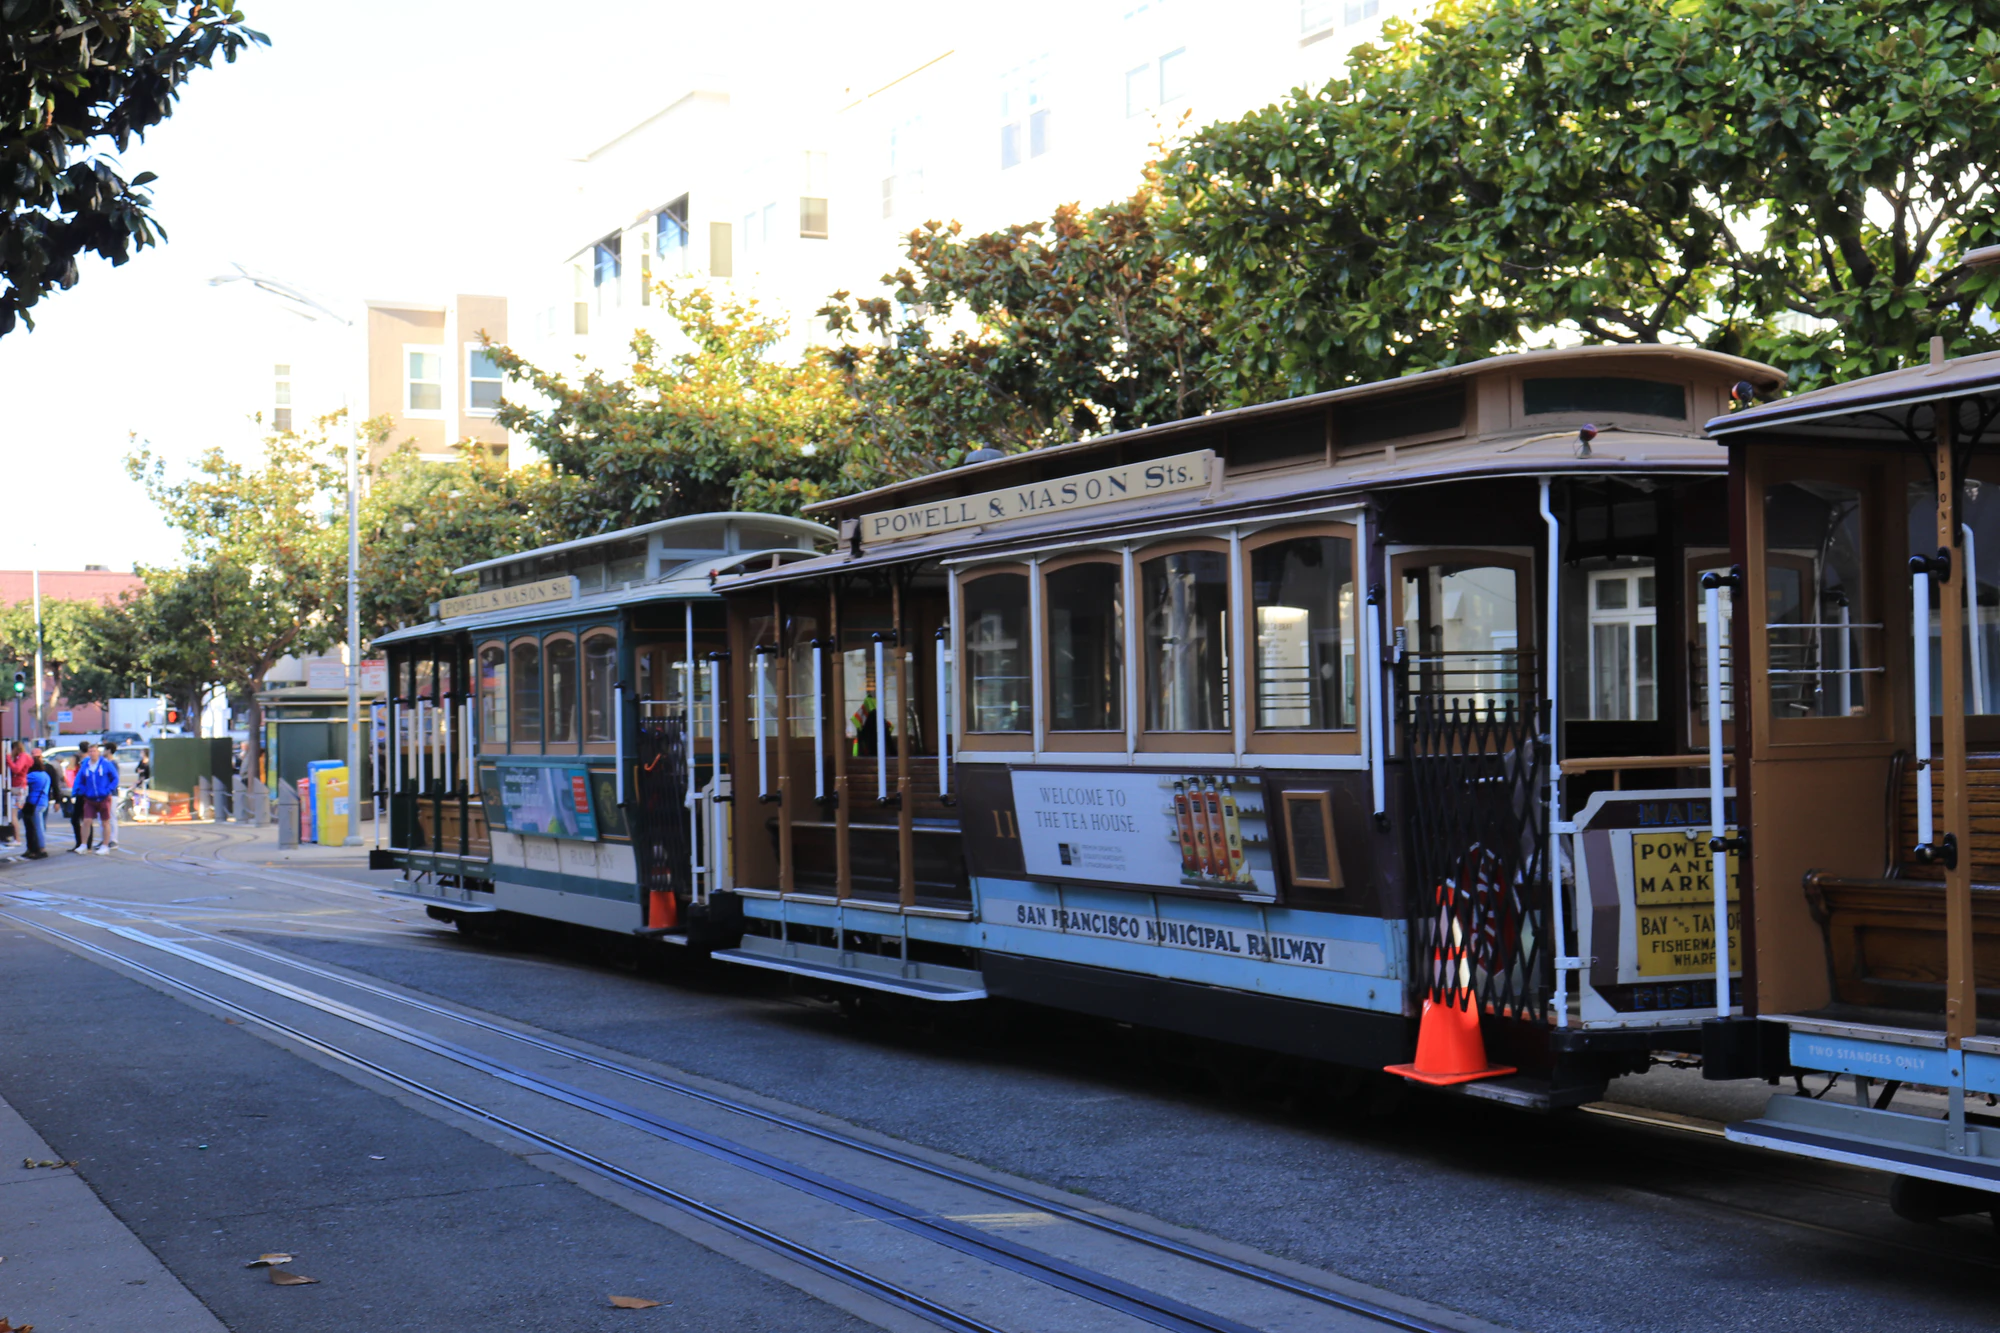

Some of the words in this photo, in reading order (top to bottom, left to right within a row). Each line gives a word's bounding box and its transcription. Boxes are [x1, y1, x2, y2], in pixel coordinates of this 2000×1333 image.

[874, 503, 977, 535] POWELL
[988, 497, 1005, 518] &
[1018, 472, 1127, 512] MASON
[1144, 464, 1193, 490] Sts.
[445, 598, 488, 614] POWELL
[503, 586, 545, 604] MASON
[1039, 787, 1104, 806] WELCOME
[1107, 789, 1126, 807] TO
[993, 810, 1017, 838] 11
[1034, 811, 1060, 828] THE
[1062, 812, 1088, 830] TEA
[1091, 814, 1140, 833] HOUSE.
[1641, 874, 1740, 893] MARKT
[1017, 905, 1047, 925] SAN
[1051, 909, 1139, 938] FRANCISCO
[1246, 933, 1326, 964] RAILWAY
[1642, 916, 1668, 935] BAY
[1693, 913, 1741, 933] TAYOR
[1652, 937, 1736, 954] FISHERMAS
[1674, 953, 1716, 966] WHARF
[1808, 1045, 1832, 1057] TWO
[1837, 1048, 1891, 1065] STANDEES
[1896, 1056, 1927, 1069] ONLY
